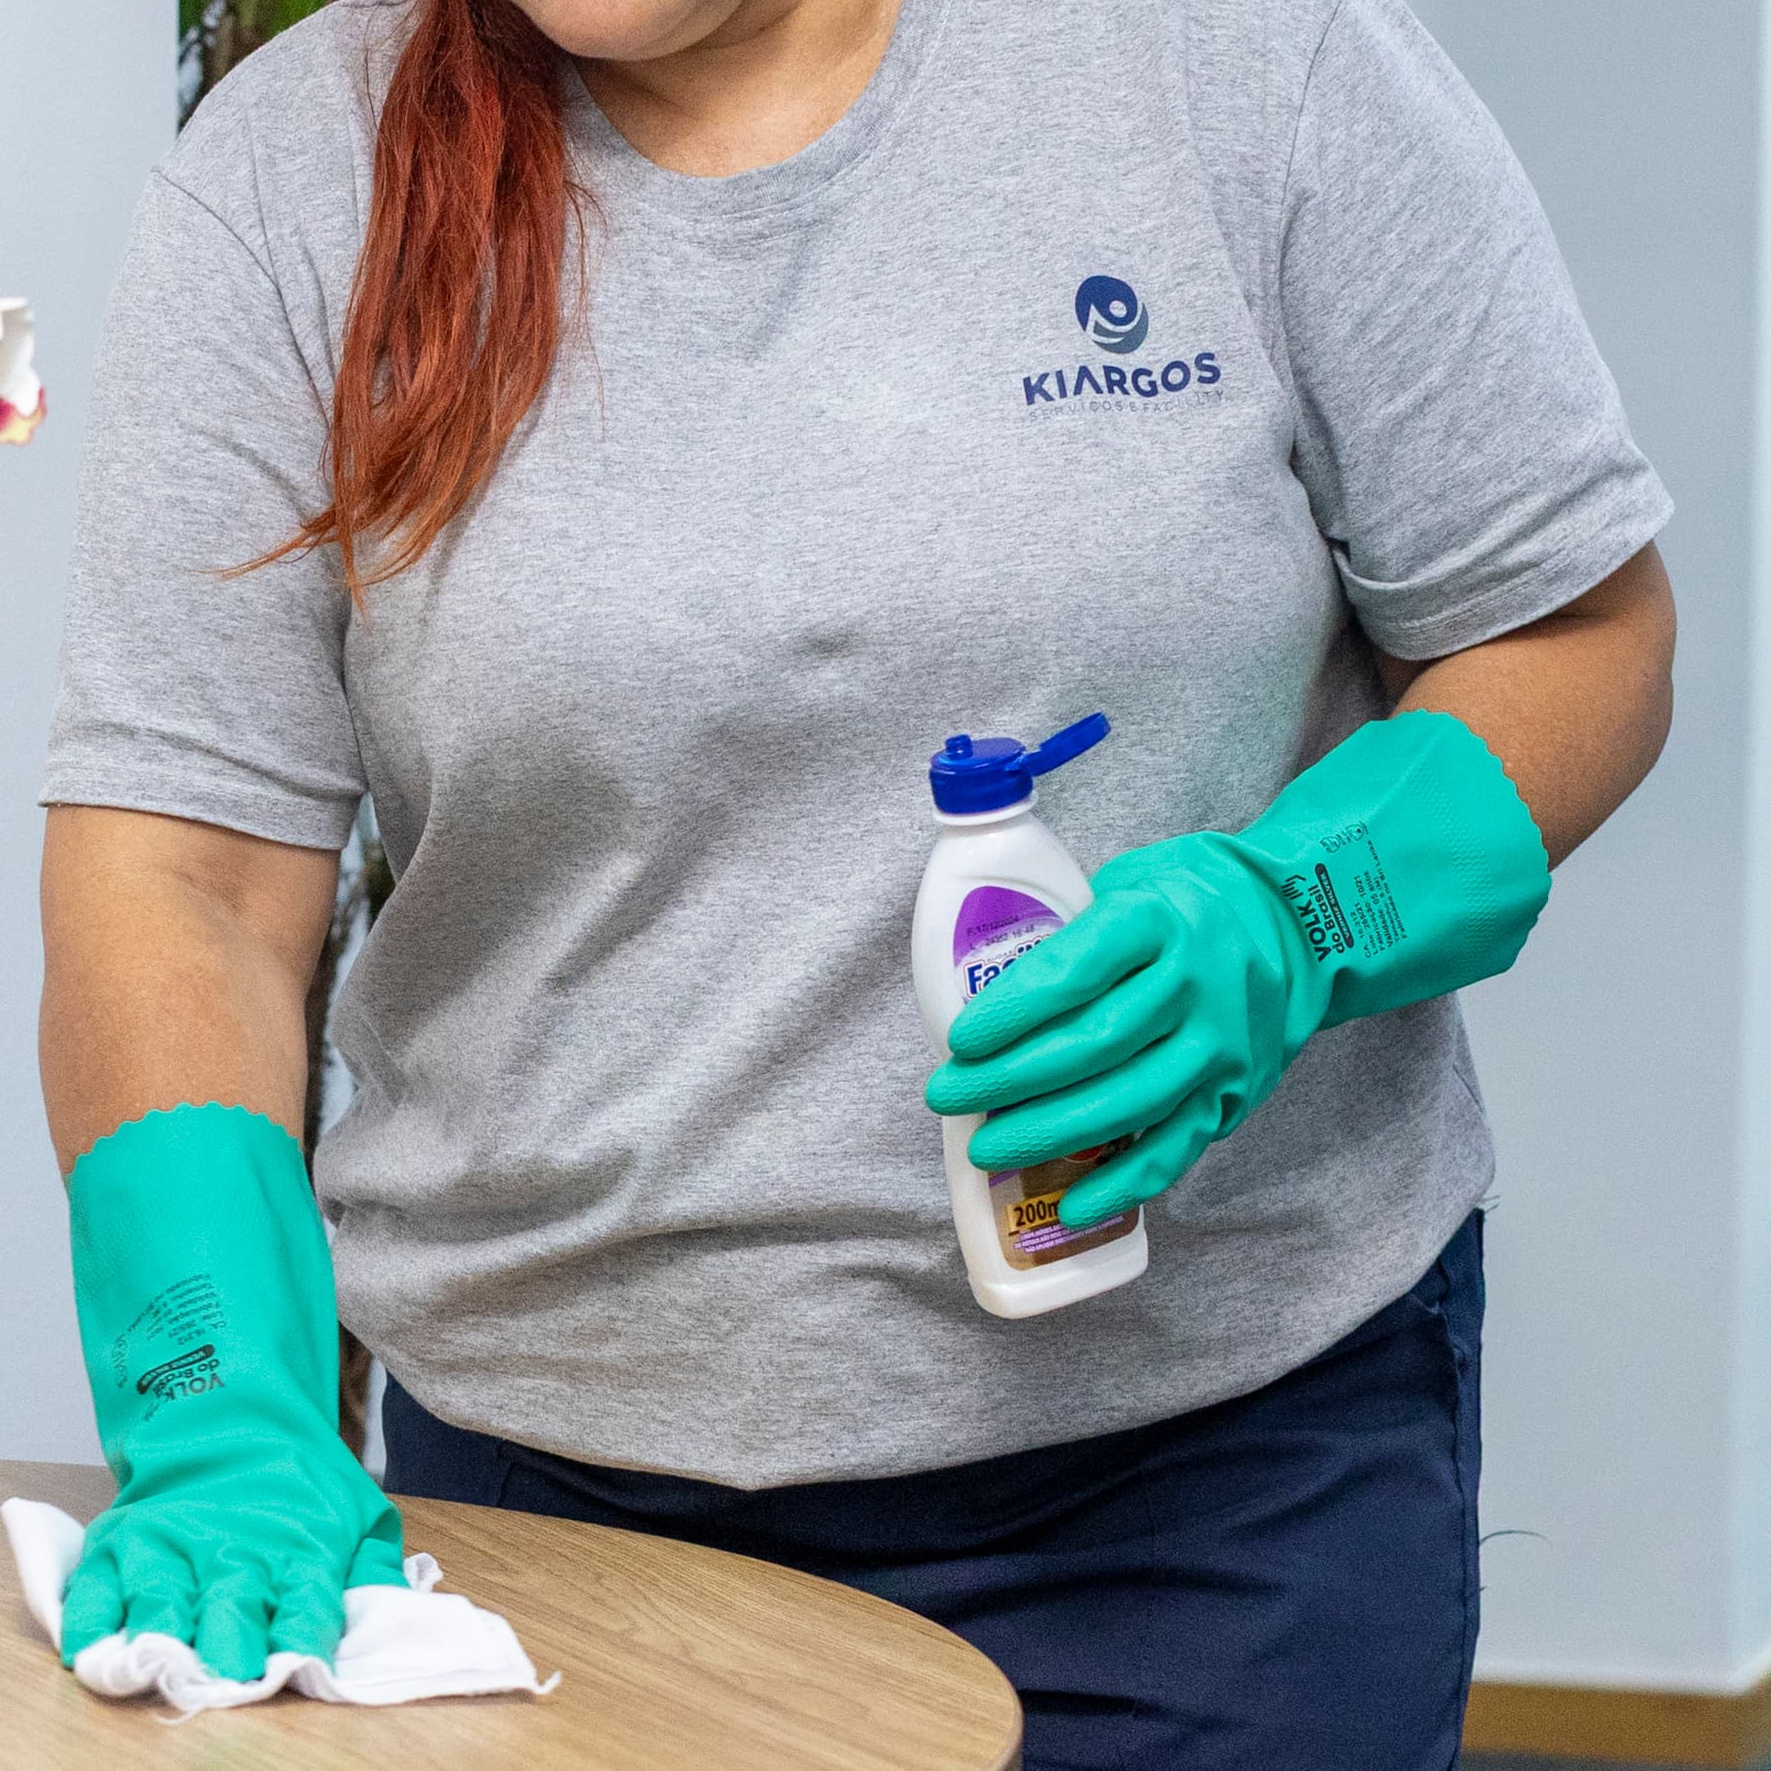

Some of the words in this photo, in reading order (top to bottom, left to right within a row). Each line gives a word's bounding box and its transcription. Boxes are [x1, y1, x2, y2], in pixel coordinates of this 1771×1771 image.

[1022, 352, 1221, 406] KIARGOS
[1308, 884, 1336, 930] Brasil
[1296, 899, 1332, 963] VOLK
[1331, 932, 1346, 954] do
[1013, 1200, 1060, 1227] 200m
[164, 1372, 225, 1401] VOLK
